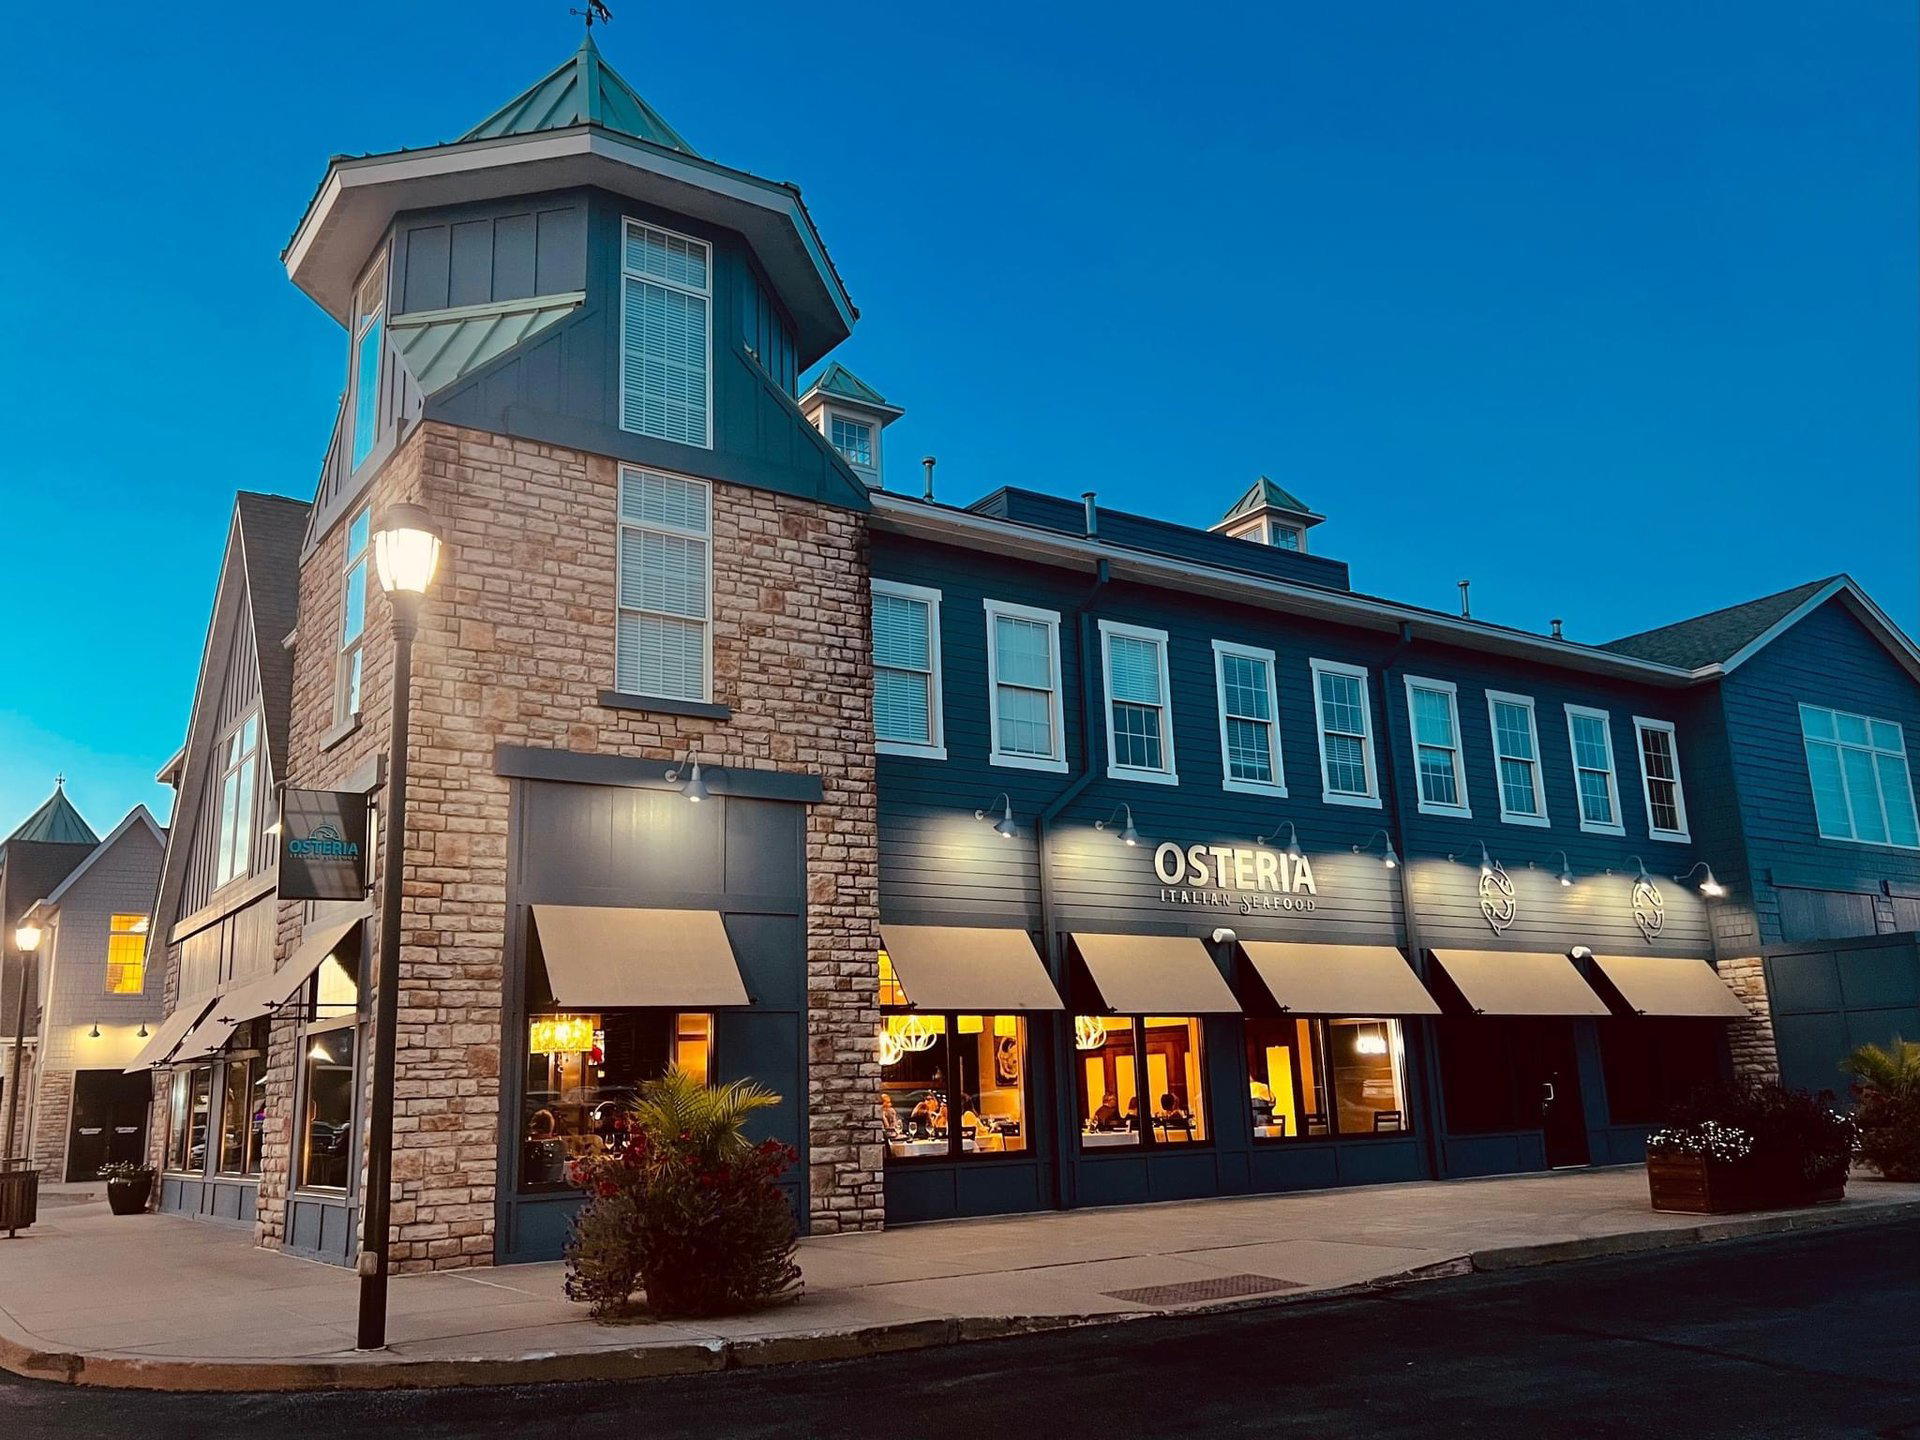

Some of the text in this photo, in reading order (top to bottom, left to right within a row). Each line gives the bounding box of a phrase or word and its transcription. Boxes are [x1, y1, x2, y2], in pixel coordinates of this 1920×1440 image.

[288, 840, 359, 855] OSTERIA
[1154, 842, 1317, 894] OSTERIA
[1160, 889, 1316, 915] ITALIAN SEAFOOD
